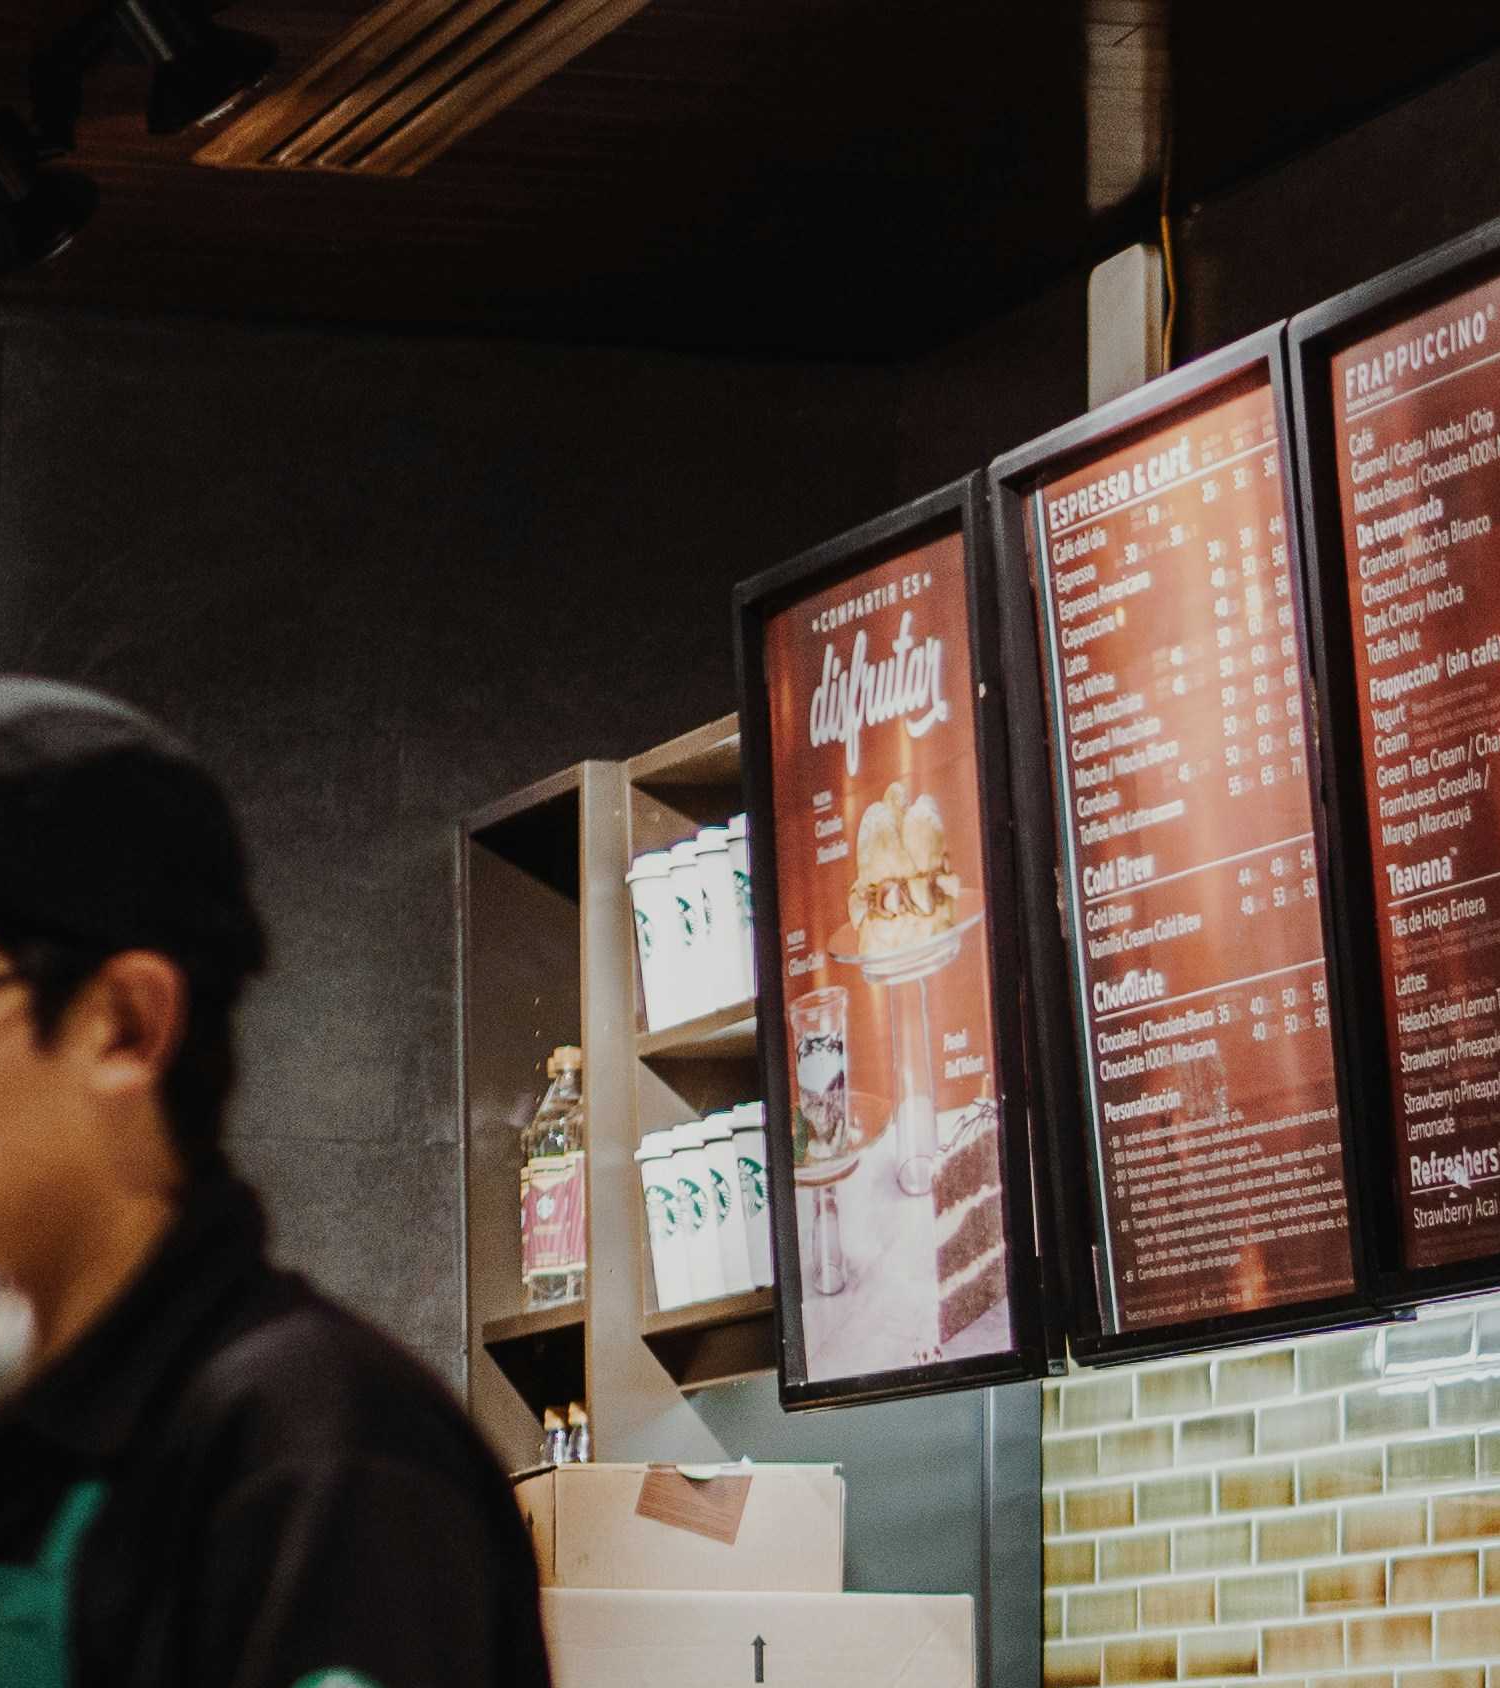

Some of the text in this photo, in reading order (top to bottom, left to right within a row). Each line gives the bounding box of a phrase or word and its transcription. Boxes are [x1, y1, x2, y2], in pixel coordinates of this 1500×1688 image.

[1348, 427, 1374, 457] Café
[1350, 449, 1388, 484] Caramel
[1429, 421, 1464, 449] Mocha
[1469, 407, 1495, 435] Chip
[1049, 469, 1131, 529] ESPRESSO
[1147, 435, 1192, 487] CAFÉ
[1355, 495, 1443, 550] De temporada
[1449, 514, 1491, 543] Blanco
[1055, 563, 1098, 594] Espresso
[1408, 559, 1447, 588] Praliné
[820, 573, 921, 632] COMPARTIR ES
[1363, 608, 1389, 637] Dark
[1387, 600, 1426, 627] Cherry
[1425, 584, 1464, 613] Mocha
[1365, 637, 1400, 665] Toffee
[1398, 630, 1421, 654] Nut
[1445, 647, 1470, 678] (sin
[810, 610, 949, 777] disfrutar
[1370, 703, 1406, 732] Yogurt
[1373, 730, 1409, 759] Cream
[1375, 763, 1409, 789] Green
[1407, 754, 1430, 777] Tea
[1429, 745, 1466, 772] Cream
[1378, 787, 1437, 818] Frambuesa
[1436, 768, 1482, 801] Grosella
[1381, 805, 1471, 846] Mango Maracuyá
[1082, 854, 1156, 896] Cold Brew
[1085, 905, 1109, 932] Cold
[1407, 910, 1422, 933] de
[1422, 902, 1450, 930] Hoja
[1449, 897, 1487, 922] Entera
[1122, 926, 1155, 951] Cream
[1394, 973, 1428, 996] Lattes
[1461, 995, 1496, 1019] Lemon
[1096, 1027, 1139, 1054] Chocolate
[1099, 1038, 1218, 1081] Chocolate Mexicano
[1399, 1047, 1449, 1073] Strawberry
[1104, 1083, 1184, 1122] Personalización
[1403, 1087, 1453, 1114] Strawberry
[1406, 1114, 1455, 1141] Lemonade
[1413, 1203, 1473, 1229] Strawberry
[1474, 1193, 1499, 1217] Acai
